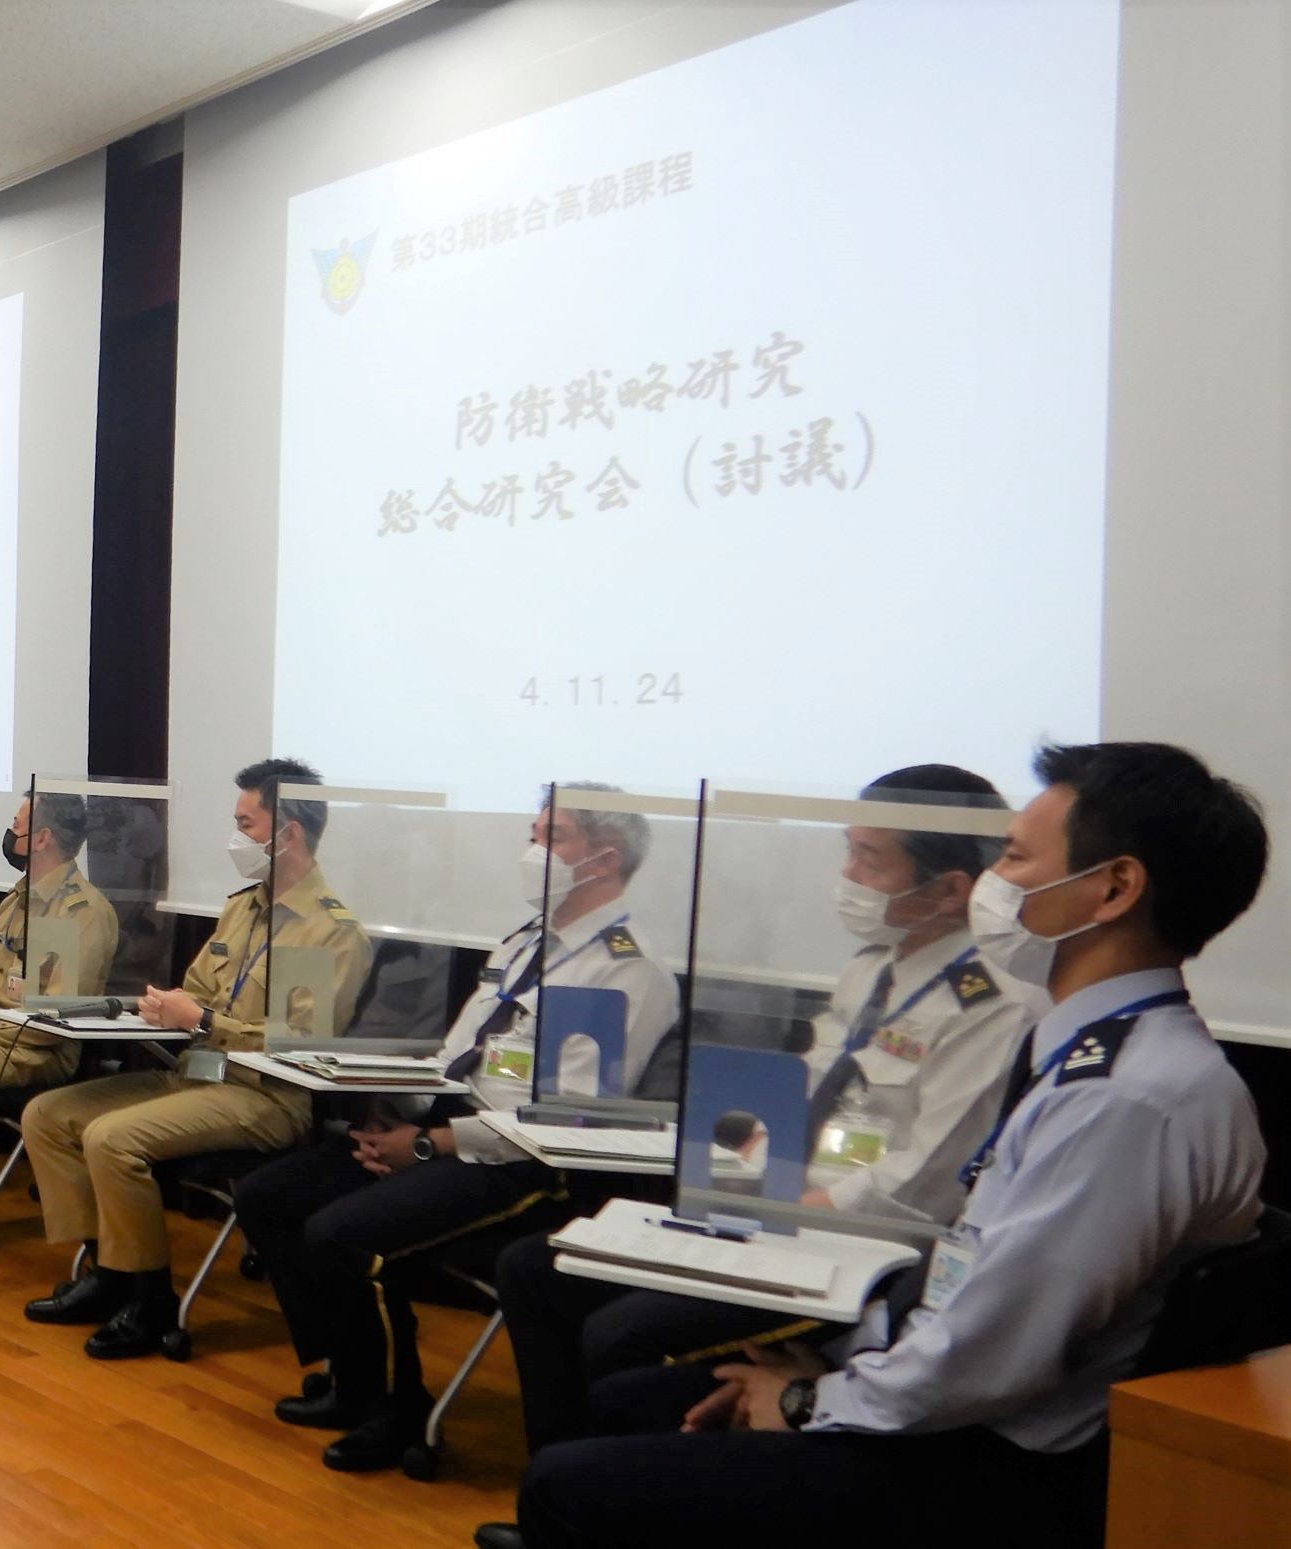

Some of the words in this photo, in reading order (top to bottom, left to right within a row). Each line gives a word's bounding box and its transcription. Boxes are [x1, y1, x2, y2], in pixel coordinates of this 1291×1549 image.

[389, 151, 694, 274] 第33期統合高級課程
[455, 331, 805, 450] 防衛戦略研究
